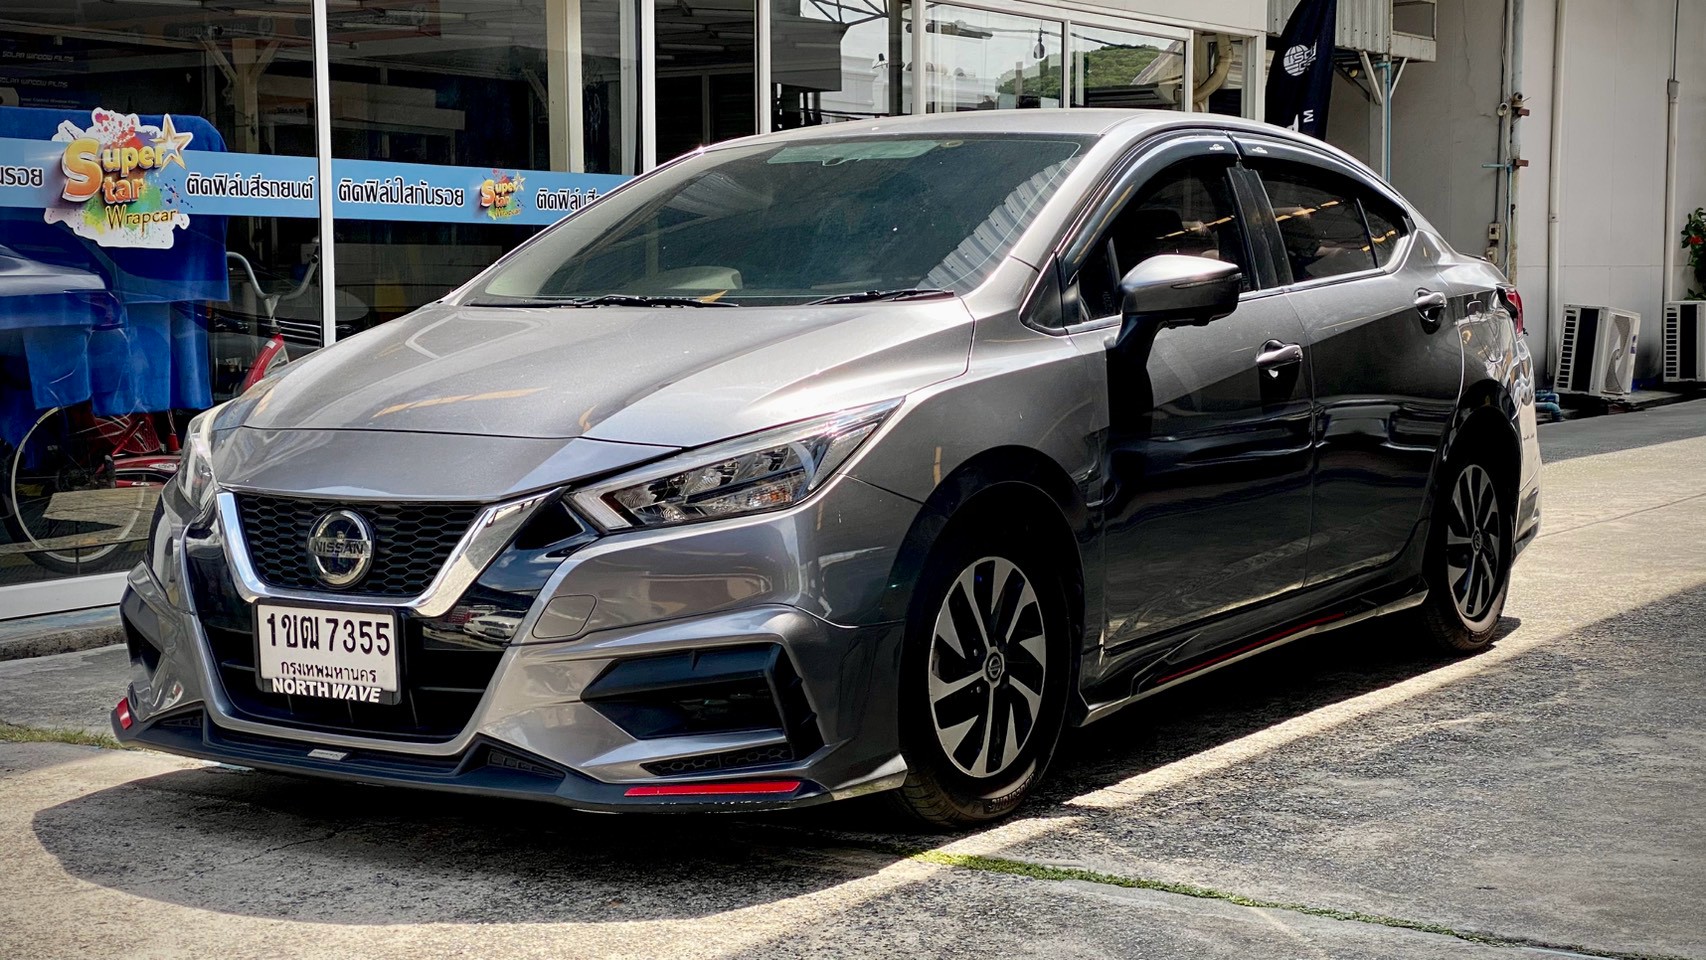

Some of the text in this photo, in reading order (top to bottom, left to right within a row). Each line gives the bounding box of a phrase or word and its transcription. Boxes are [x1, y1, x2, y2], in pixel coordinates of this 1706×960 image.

[186, 172, 315, 199] ติดฟิล์มสีรถยนต์
[338, 176, 464, 207] ติดฟิล์มใสกันรอย
[105, 204, 177, 237] Wrapcar
[314, 541, 364, 555] NISSAN
[325, 618, 391, 657] 7355
[272, 678, 381, 703] NORTH WAVE
